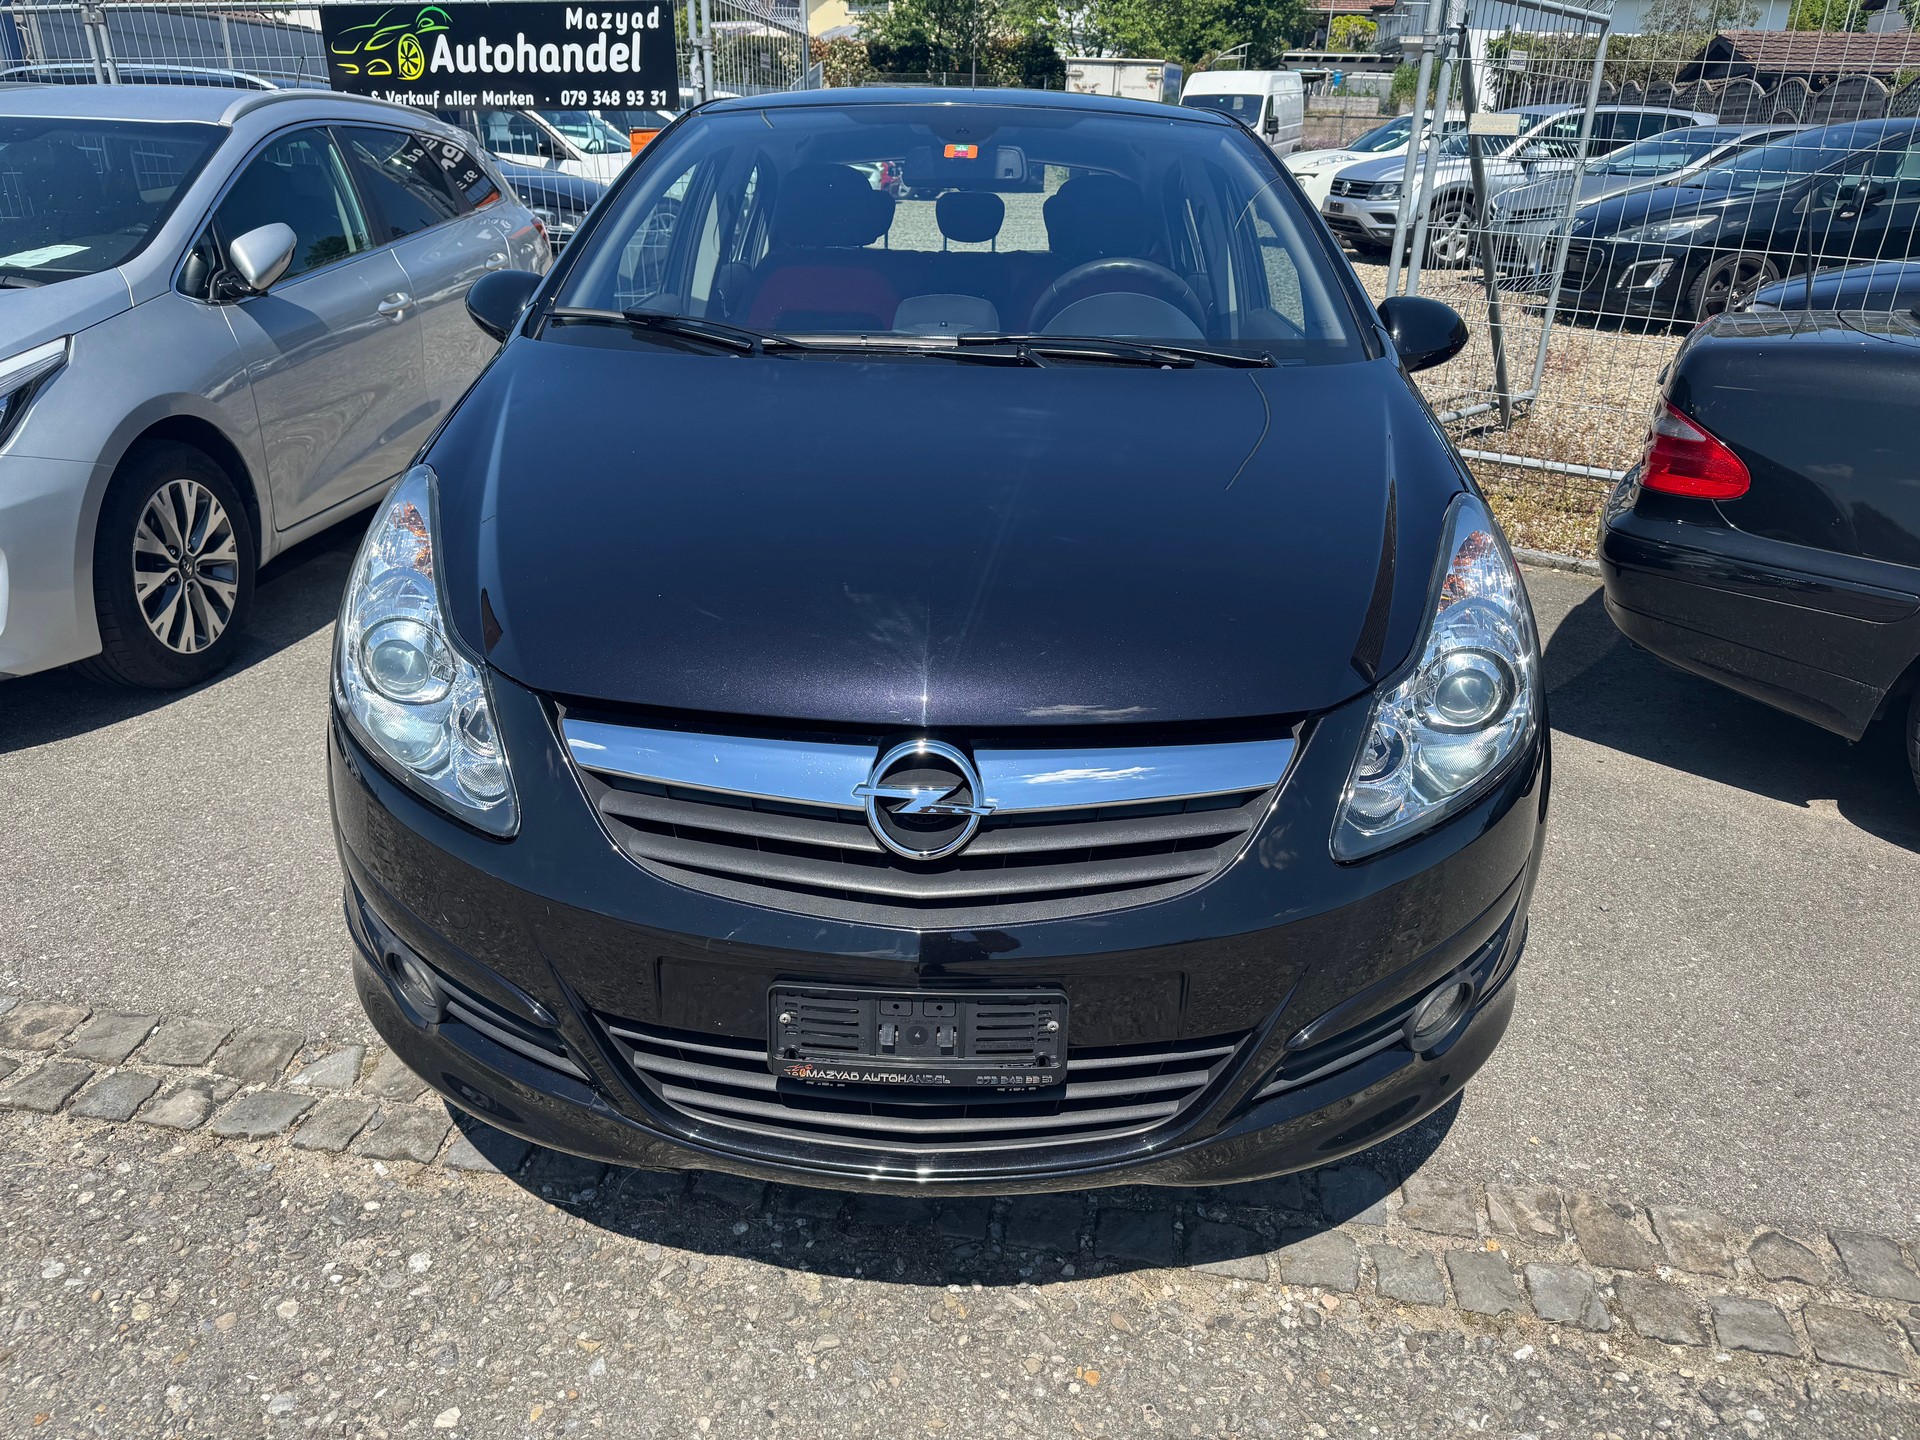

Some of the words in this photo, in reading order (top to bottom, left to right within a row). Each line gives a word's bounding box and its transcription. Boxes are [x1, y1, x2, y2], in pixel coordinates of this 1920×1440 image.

[565, 5, 660, 36] Mazyad
[429, 31, 642, 74] Autohandel
[385, 90, 441, 109] Verkauf
[444, 90, 478, 106] aller
[482, 90, 535, 106] Marken
[560, 90, 588, 106] 079
[592, 90, 621, 106] 348
[625, 90, 645, 107] 93
[649, 90, 667, 107] 31
[806, 1069, 860, 1081] MAZYAD
[862, 1072, 951, 1085] AUTOHANDEL
